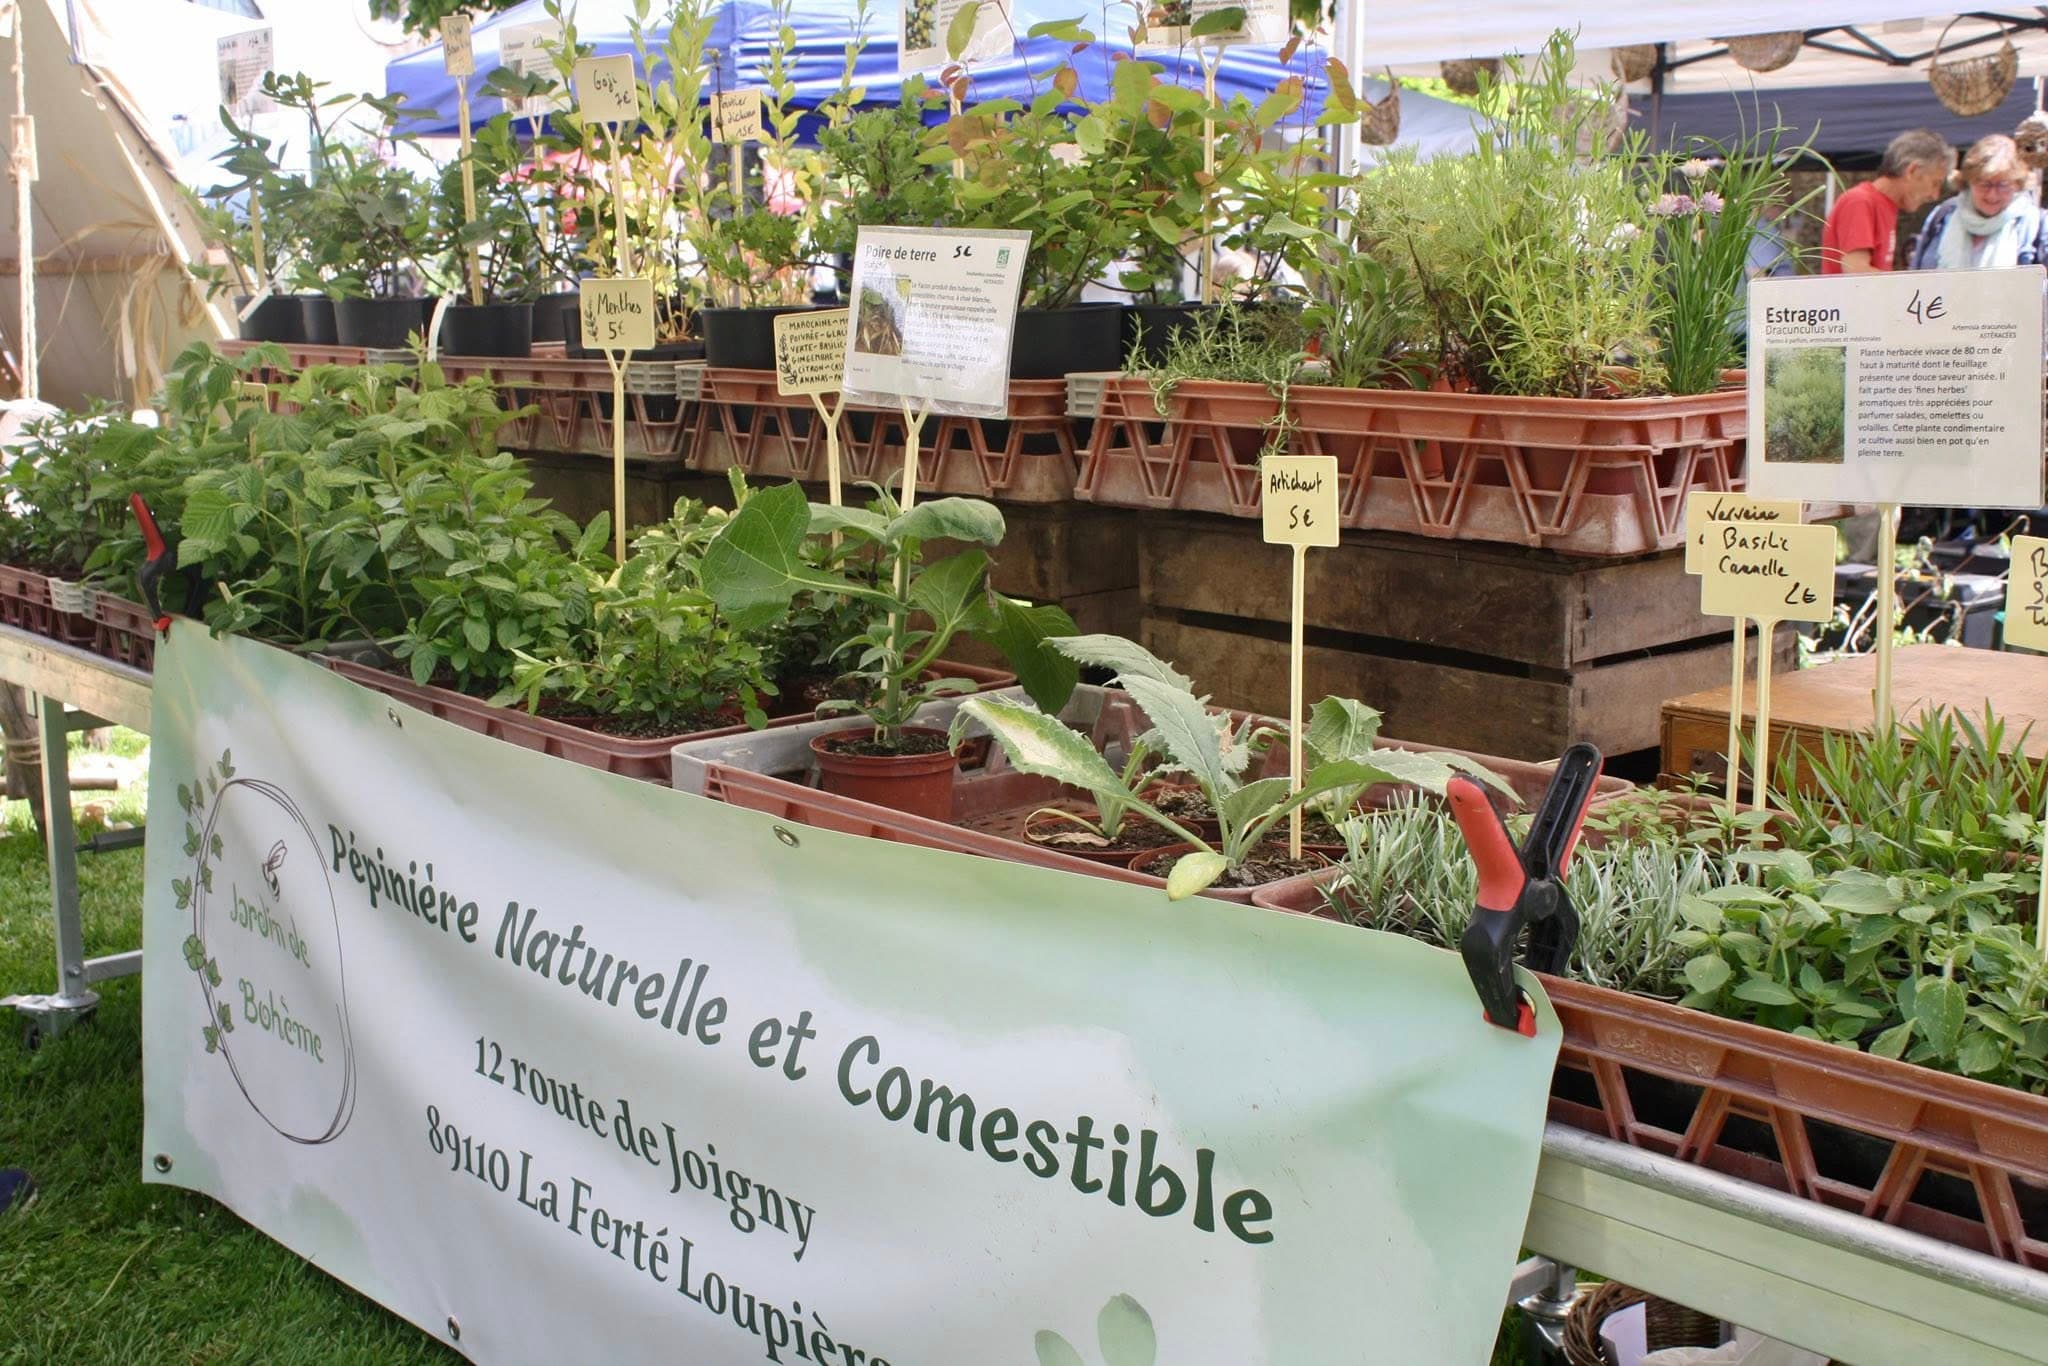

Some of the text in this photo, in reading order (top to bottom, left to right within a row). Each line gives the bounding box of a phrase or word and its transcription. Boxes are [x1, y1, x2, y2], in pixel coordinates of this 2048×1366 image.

[594, 69, 617, 93] Goji
[866, 244, 937, 262] Poire de terre
[597, 291, 642, 316] Menthes
[1766, 289, 1948, 326] Estragon 4€
[608, 321, 625, 340] 5€
[789, 319, 832, 330] MAROCAINE
[1766, 322, 1848, 336] Dracunculus vrai
[790, 329, 820, 343] POIVRÉE
[790, 341, 845, 354] VERTE BASILIC
[1860, 346, 2003, 357] Plante herbacée vivace de 80 cm de
[791, 353, 833, 365] GINGEMBRE
[1860, 360, 1877, 369] haut
[1886, 359, 1921, 369] maturité
[1922, 359, 1941, 369] dont
[1942, 359, 1950, 369] le
[1952, 359, 1988, 369] feuillage
[798, 364, 824, 375] CITRON
[799, 374, 829, 385] ANANAS
[1859, 373, 1894, 382] présente
[1912, 372, 1937, 381] douce
[1938, 373, 1965, 381] saveur
[1967, 372, 1998, 381] anisée.
[1858, 385, 1872, 394] fait
[1873, 385, 1897, 396] partie
[1898, 385, 1913, 394] des
[1858, 398, 1993, 409] aromatiques très appréciées pour
[1858, 411, 1984, 421] parfumer salades, omelettes ou
[1892, 423, 1913, 432] Cette
[1915, 423, 1942, 435] plante
[1943, 423, 2005, 433] condimentaire
[1858, 437, 1866, 445] se
[1867, 435, 1894, 445] cultive
[1895, 436, 1915, 445] aussi
[1916, 436, 1935, 445] bien
[1936, 437, 1948, 445] en
[1949, 436, 1964, 447] pot
[1857, 448, 1905, 458] pleine terre.
[1270, 470, 1322, 494] Artichaut
[1289, 505, 1314, 530] 5€
[230, 882, 311, 968] Jardin de
[239, 978, 324, 1063] Bohème
[328, 824, 1275, 1244] Pépinière Naturelle et Comestible
[475, 1036, 816, 1262] 12 route de Joigny
[427, 1105, 891, 1366] 89110 La Ferté Loupièr
